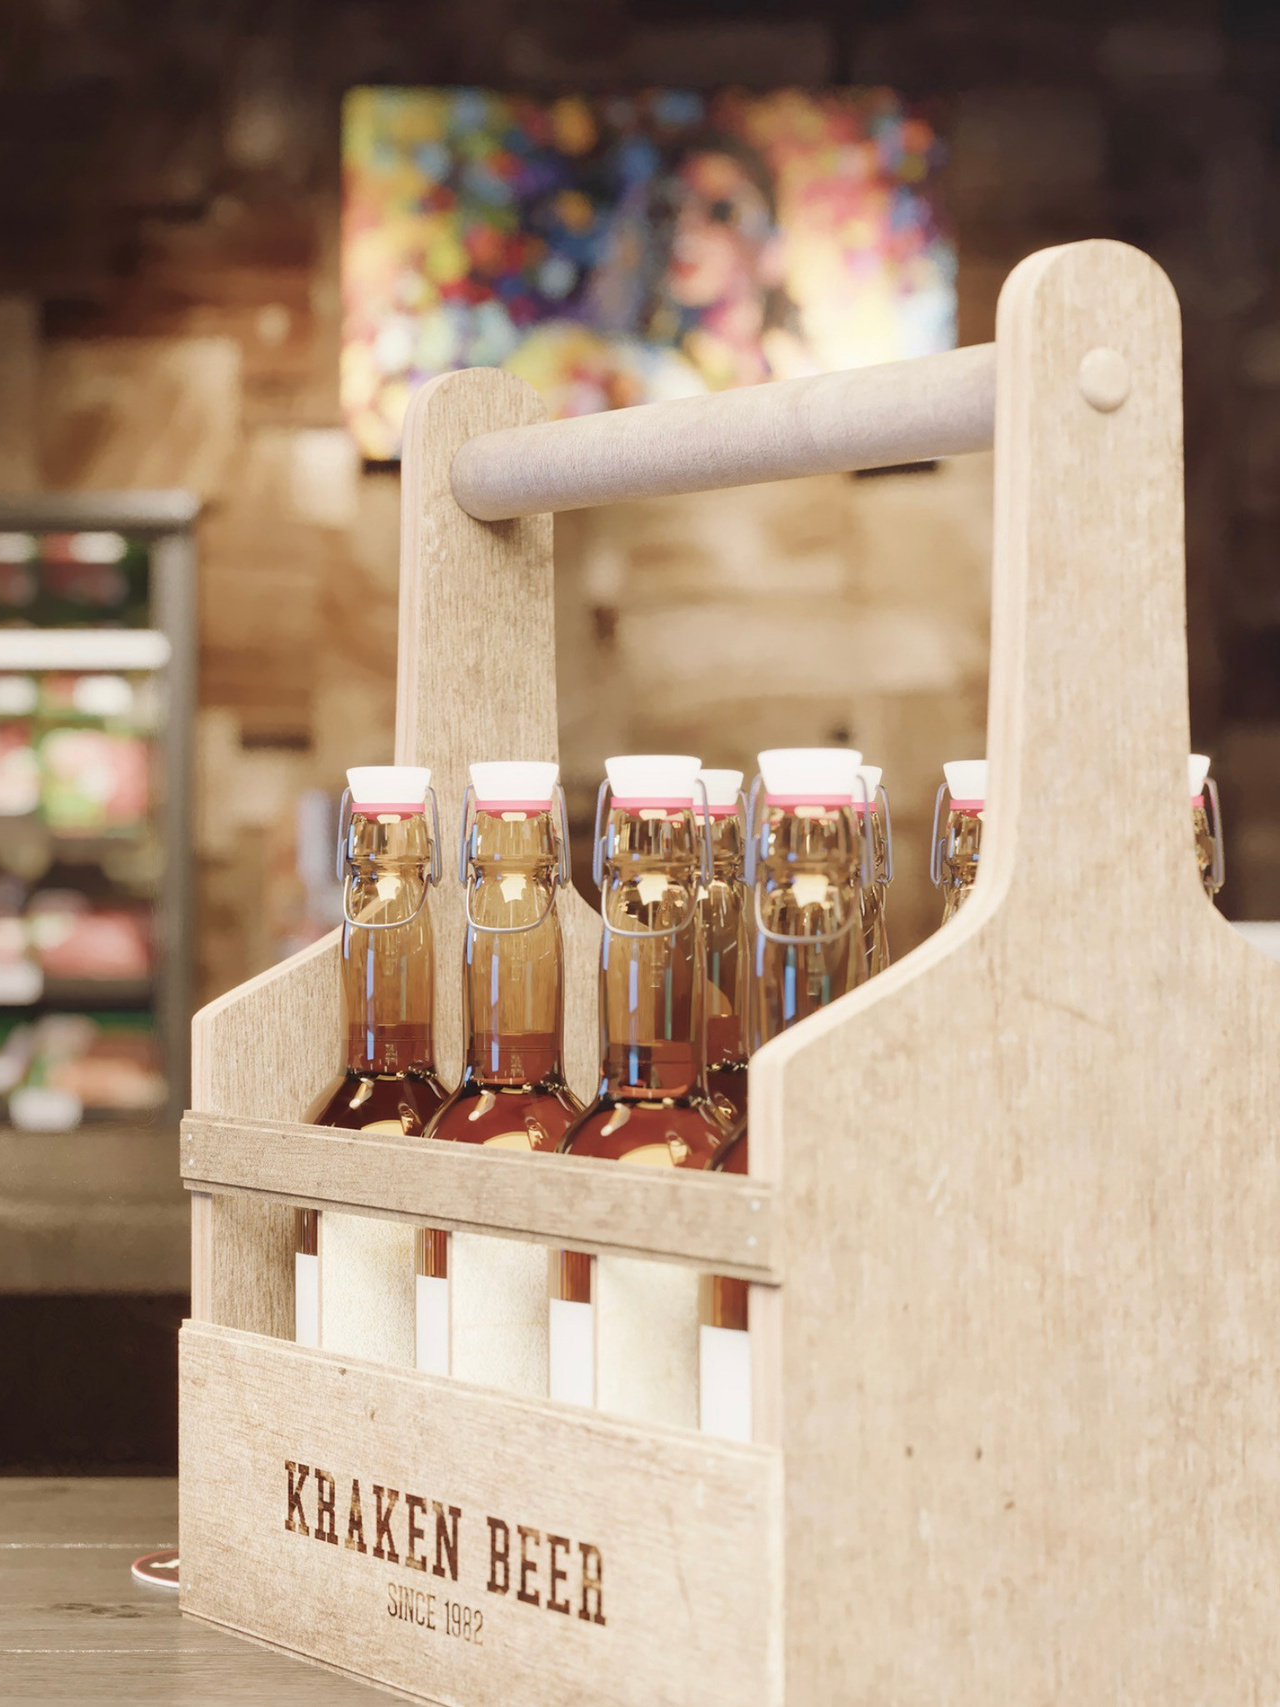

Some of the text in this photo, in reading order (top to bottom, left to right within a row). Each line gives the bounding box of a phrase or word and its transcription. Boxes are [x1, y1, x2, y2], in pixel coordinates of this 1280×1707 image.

[284, 1460, 606, 1626] KRAKEN BEER
[387, 1582, 484, 1647] SINCE 1982
